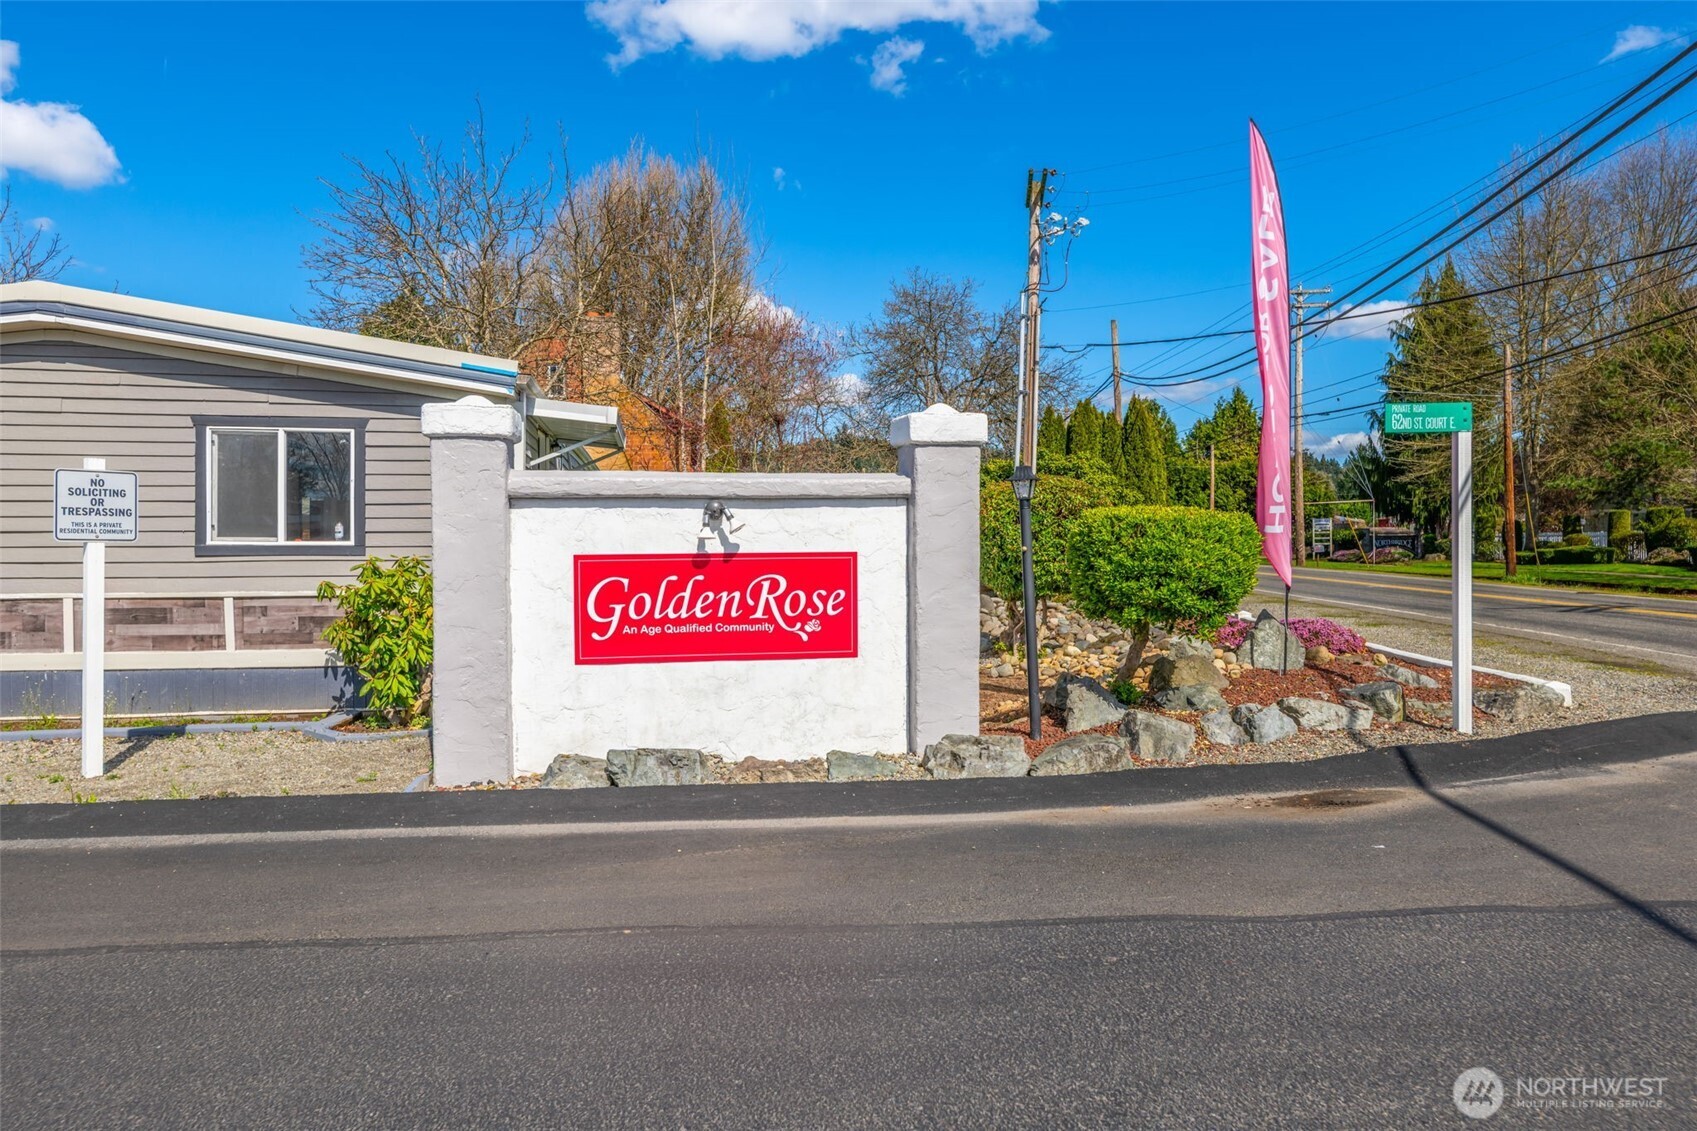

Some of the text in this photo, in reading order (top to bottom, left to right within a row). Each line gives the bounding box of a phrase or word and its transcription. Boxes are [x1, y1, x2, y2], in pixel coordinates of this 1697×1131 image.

[1391, 404, 1426, 413] PRIVATE ROAD
[1391, 414, 1412, 429] 62ND
[1425, 417, 1448, 429] COURT
[90, 478, 105, 488] NO
[67, 487, 127, 498] SOLICITING
[90, 497, 105, 507] OR
[61, 506, 133, 517] TRESPASSING
[586, 573, 846, 642] Golden Rose
[622, 622, 775, 636] An Age Qualified Community
